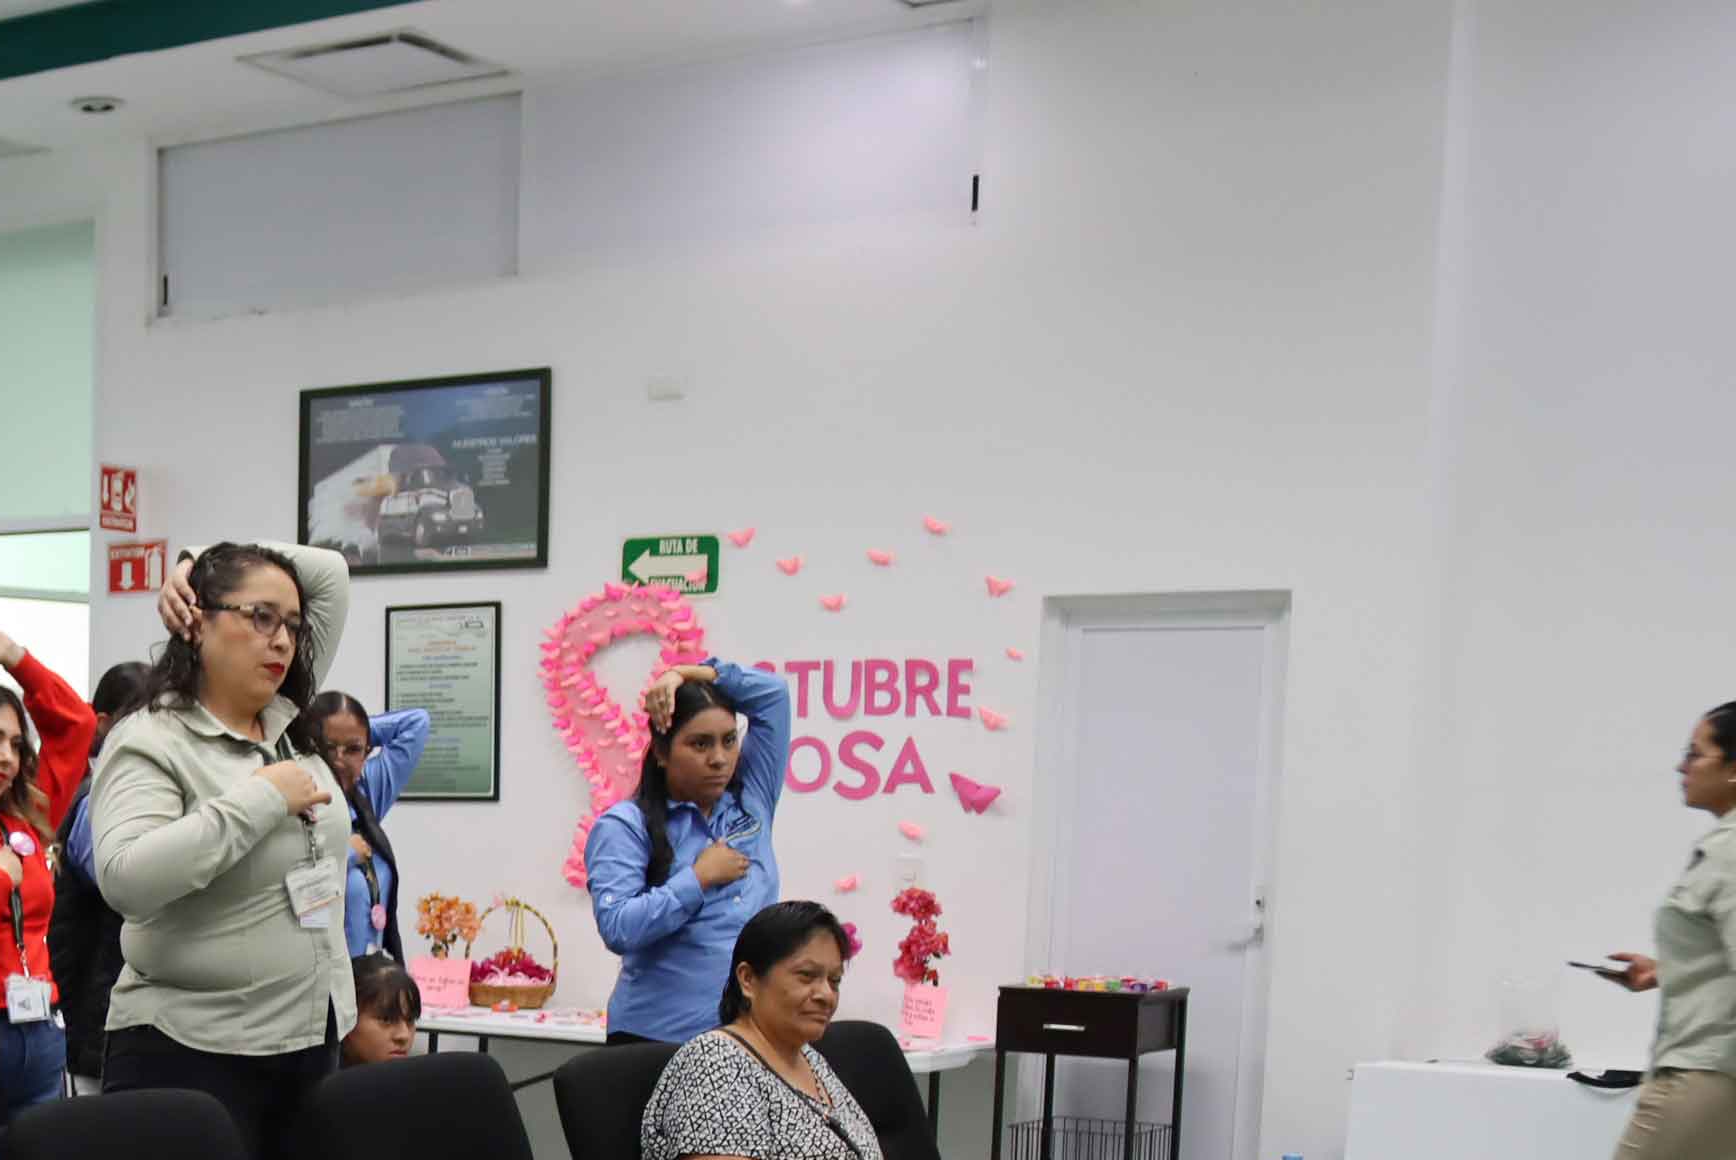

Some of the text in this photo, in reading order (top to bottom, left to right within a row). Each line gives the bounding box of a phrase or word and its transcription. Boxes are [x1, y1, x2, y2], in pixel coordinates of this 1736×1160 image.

[659, 538, 698, 554] RUTA DE
[752, 658, 974, 720] TUBRE
[783, 730, 935, 801] OSA
